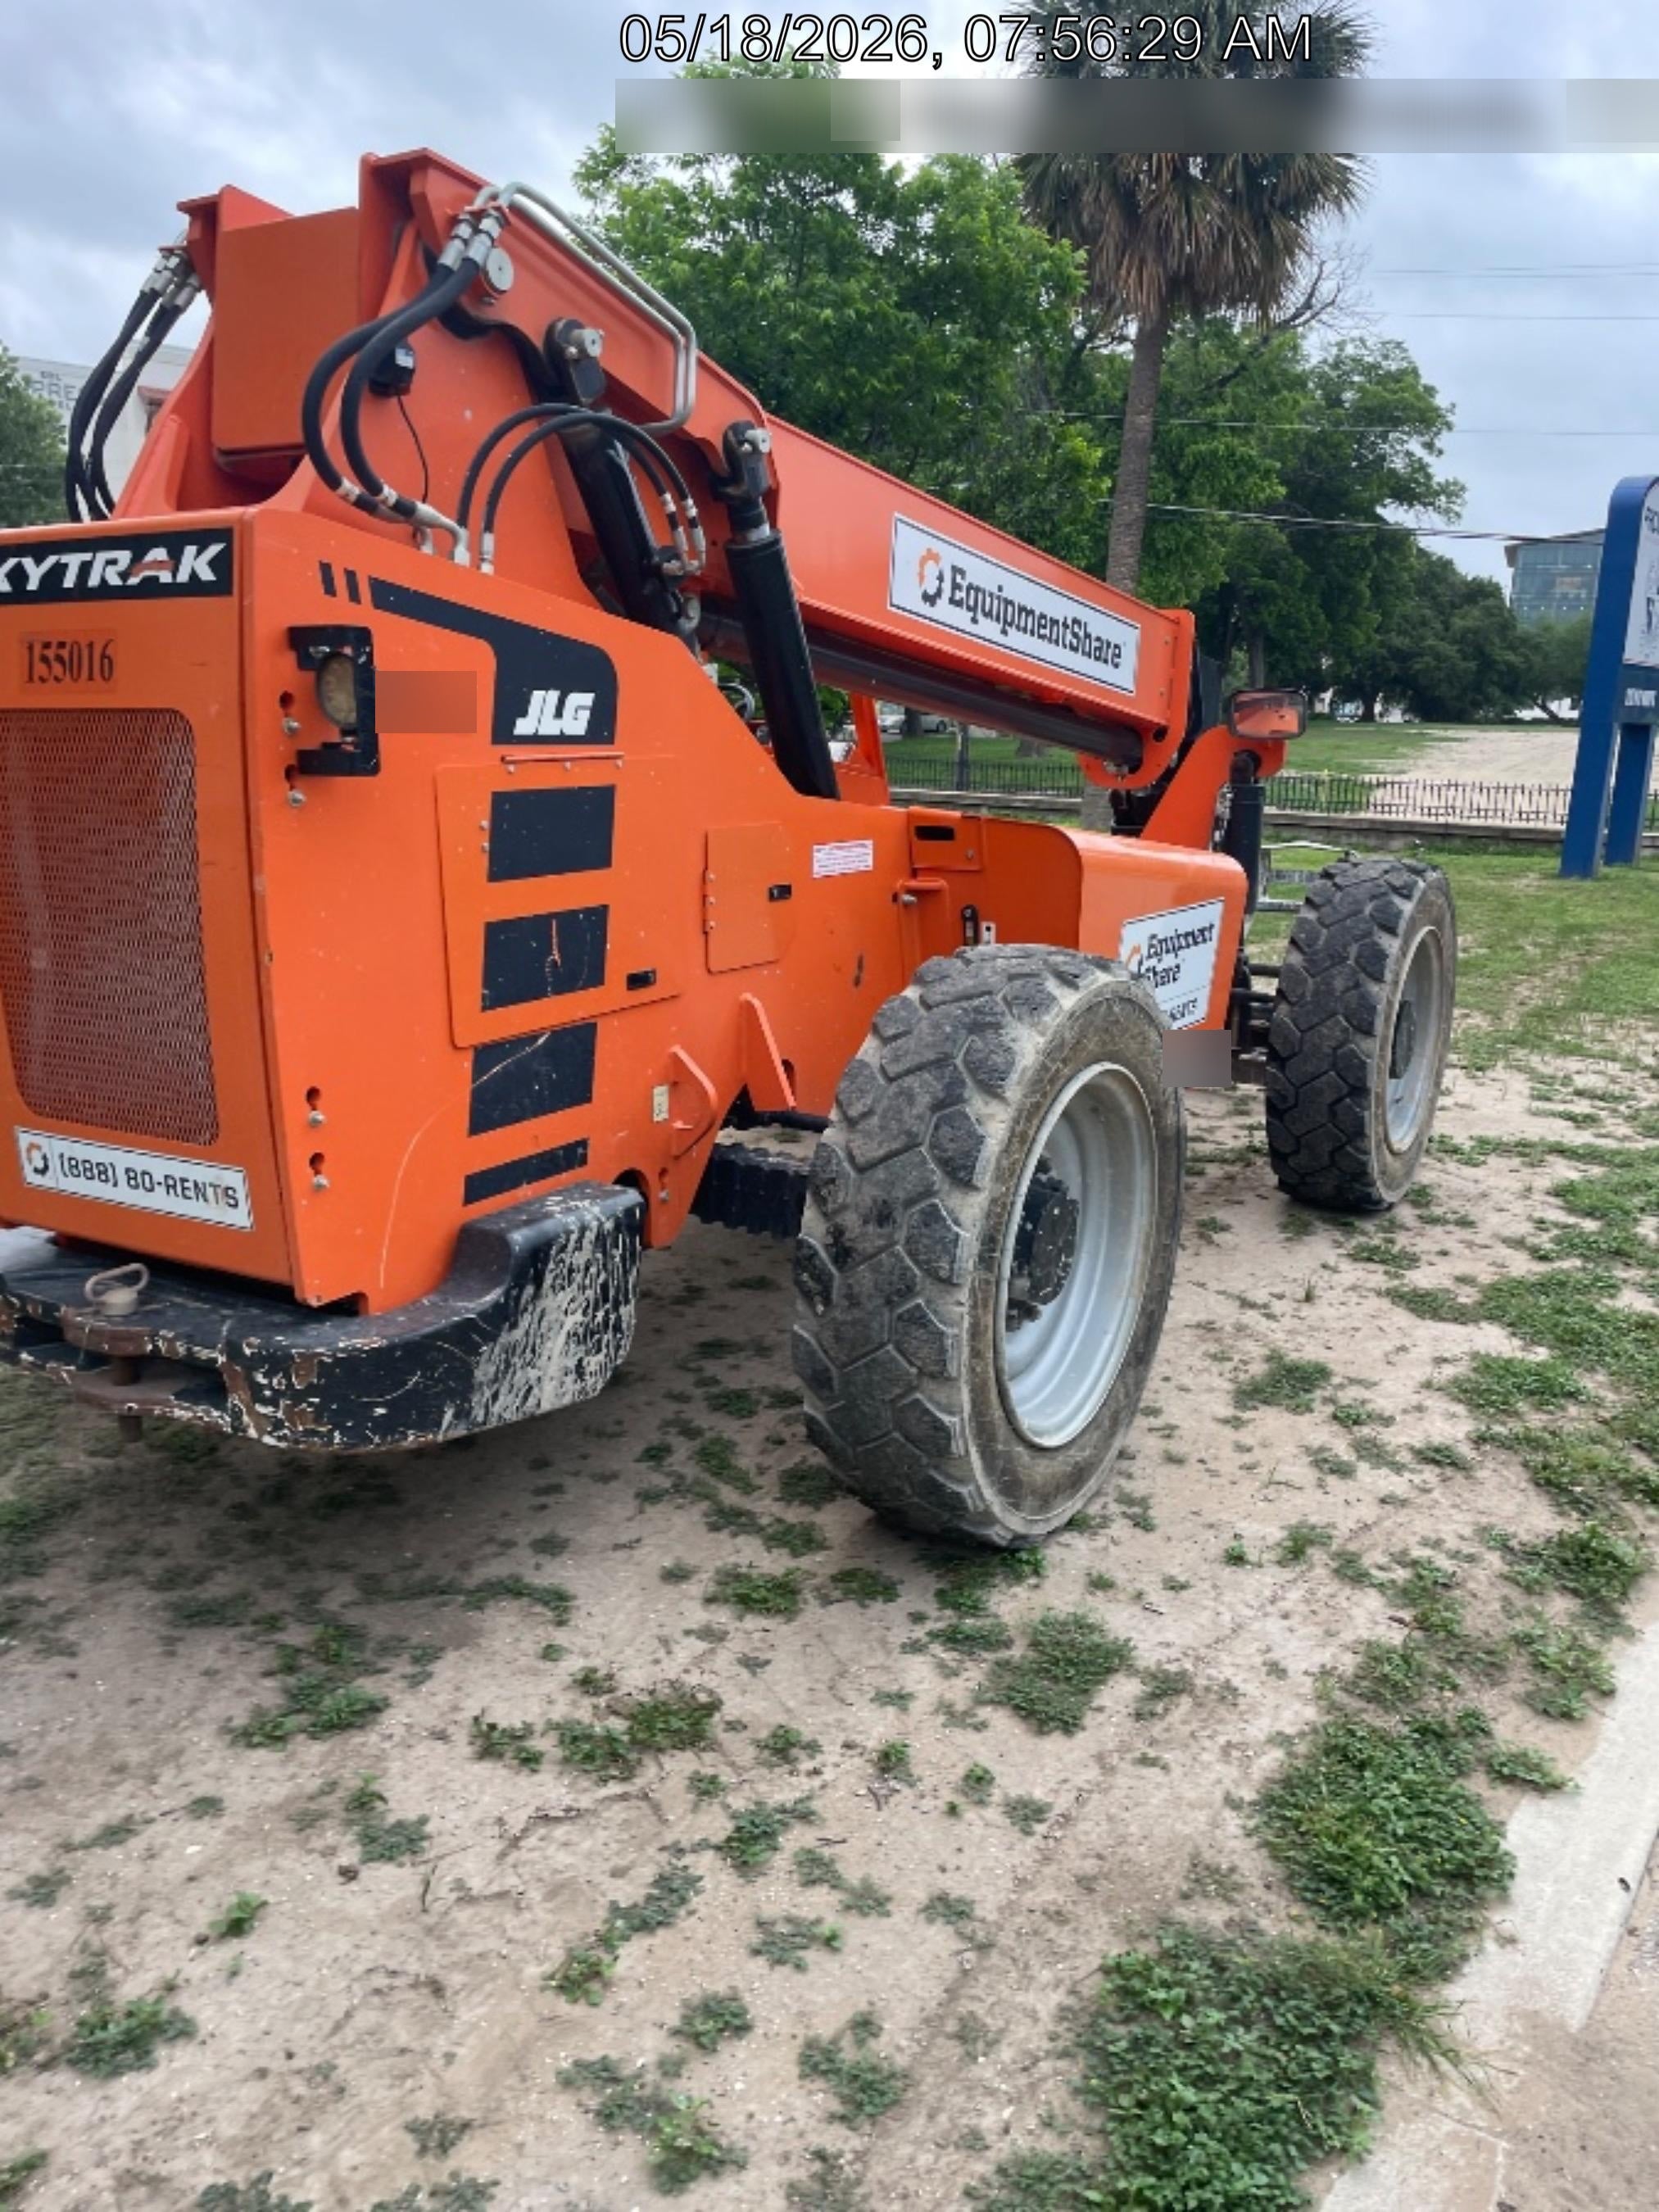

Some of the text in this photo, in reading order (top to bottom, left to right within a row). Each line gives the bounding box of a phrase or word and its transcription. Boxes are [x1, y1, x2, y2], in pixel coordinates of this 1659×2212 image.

[948, 563, 1122, 670] EquipmentShare
[25, 638, 116, 684] 155016
[513, 689, 596, 736] JLG
[1146, 922, 1214, 964] Equipment
[58, 1152, 239, 1208] (888) 80-RENTS
